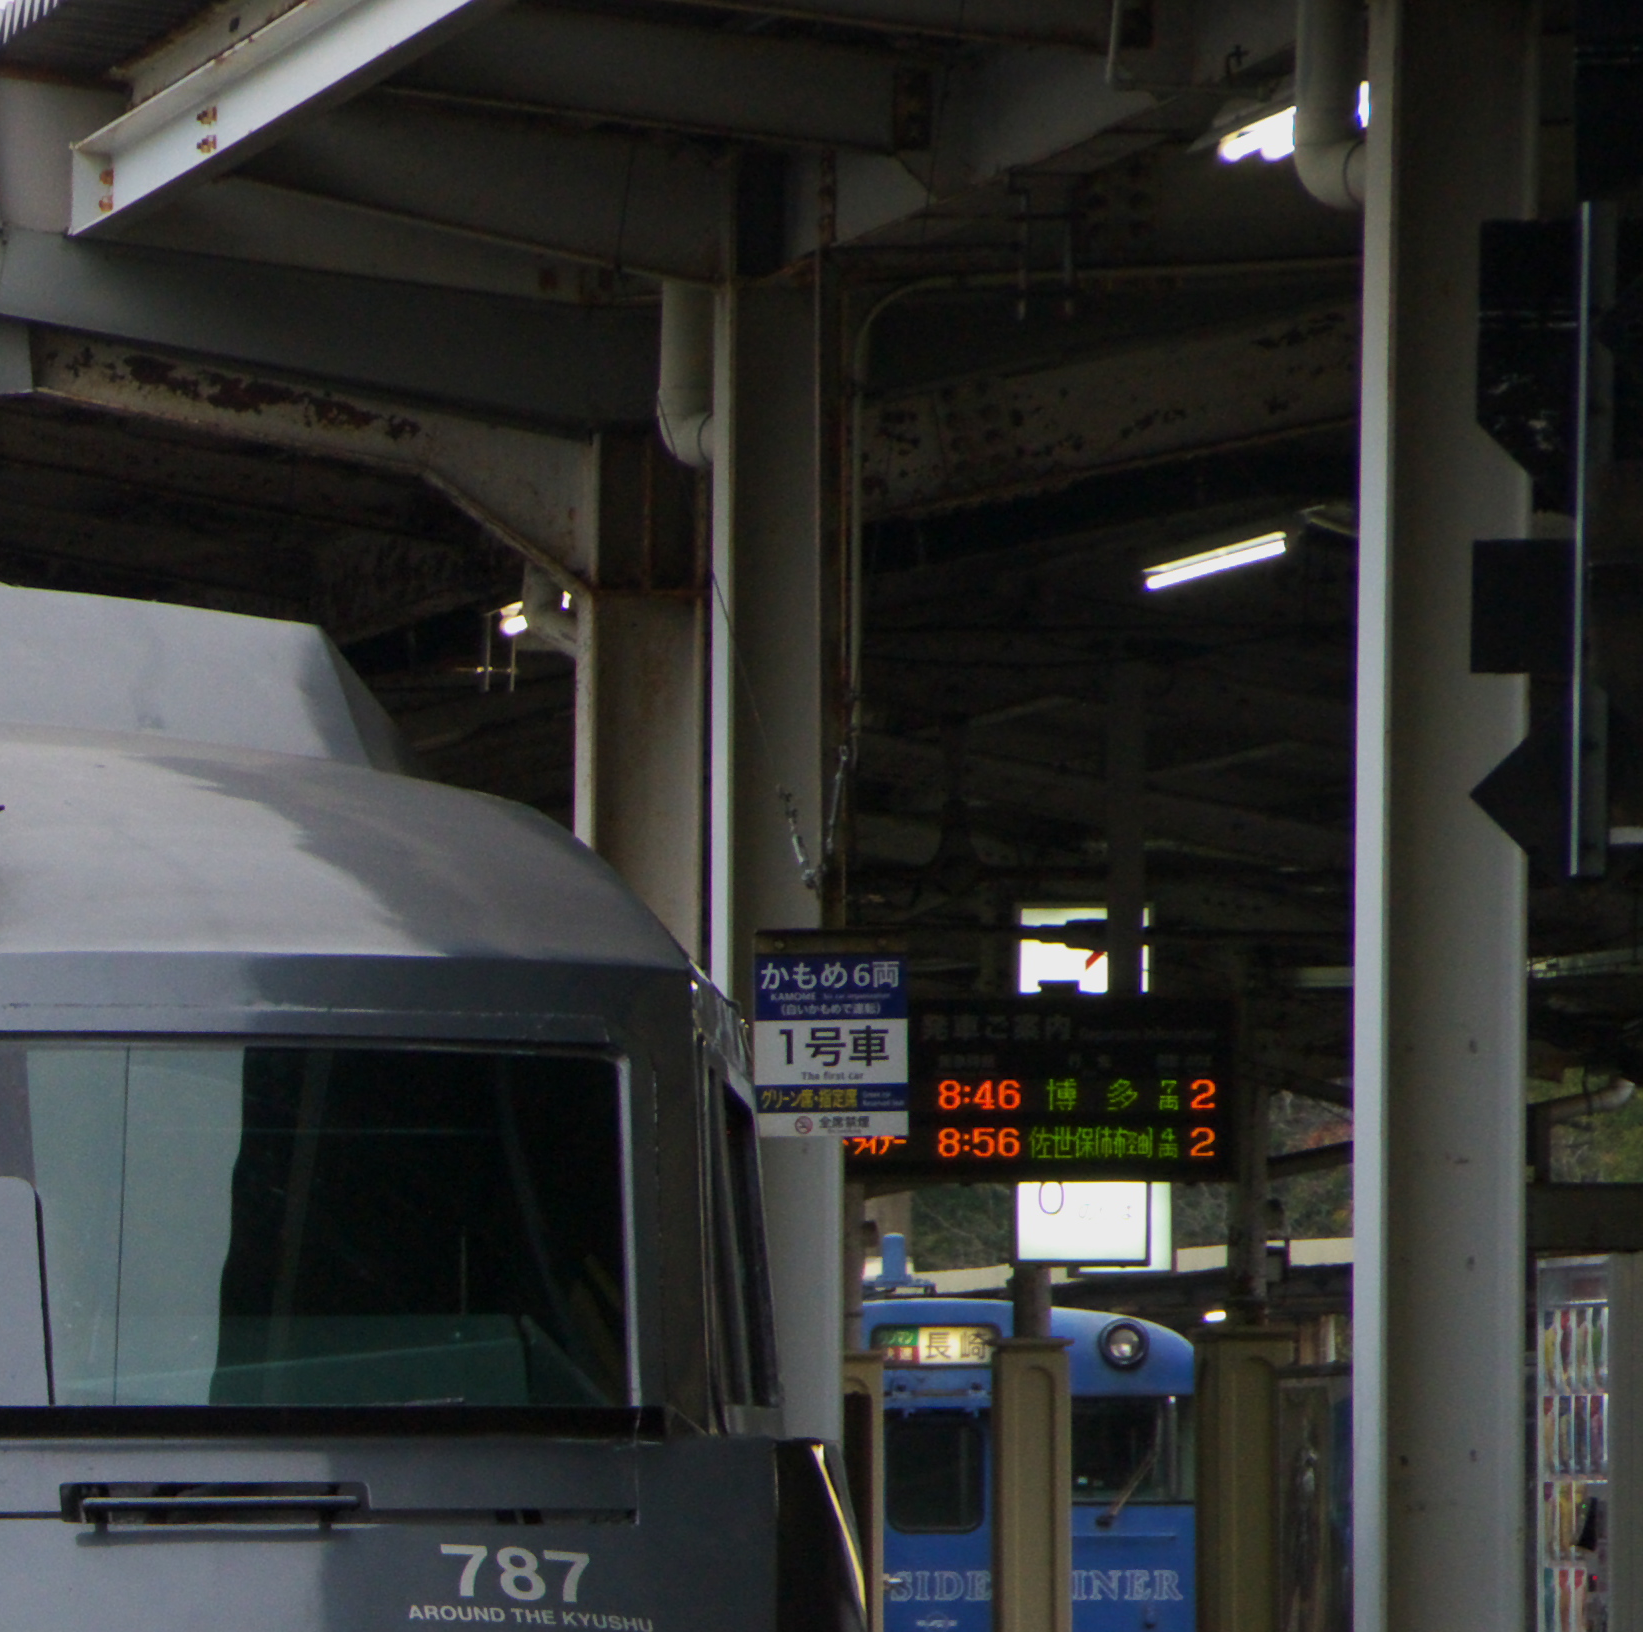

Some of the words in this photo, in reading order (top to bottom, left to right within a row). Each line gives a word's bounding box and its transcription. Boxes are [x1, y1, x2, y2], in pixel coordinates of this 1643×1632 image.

[761, 961, 900, 989] かもめ6両
[779, 1025, 890, 1067] 1号車
[801, 1071, 820, 1080] The
[823, 1071, 845, 1080] first
[848, 1072, 864, 1080] car
[937, 1078, 1022, 1110] 8:46
[1190, 1078, 1216, 1110] 2
[937, 1126, 1021, 1157] 8:56
[1190, 1126, 1216, 1157] 2
[925, 1331, 992, 1360] 長崎
[440, 1543, 590, 1603] 787
[1071, 1569, 1183, 1601] INER
[409, 1604, 505, 1623] AROUND
[511, 1607, 557, 1625] THE
